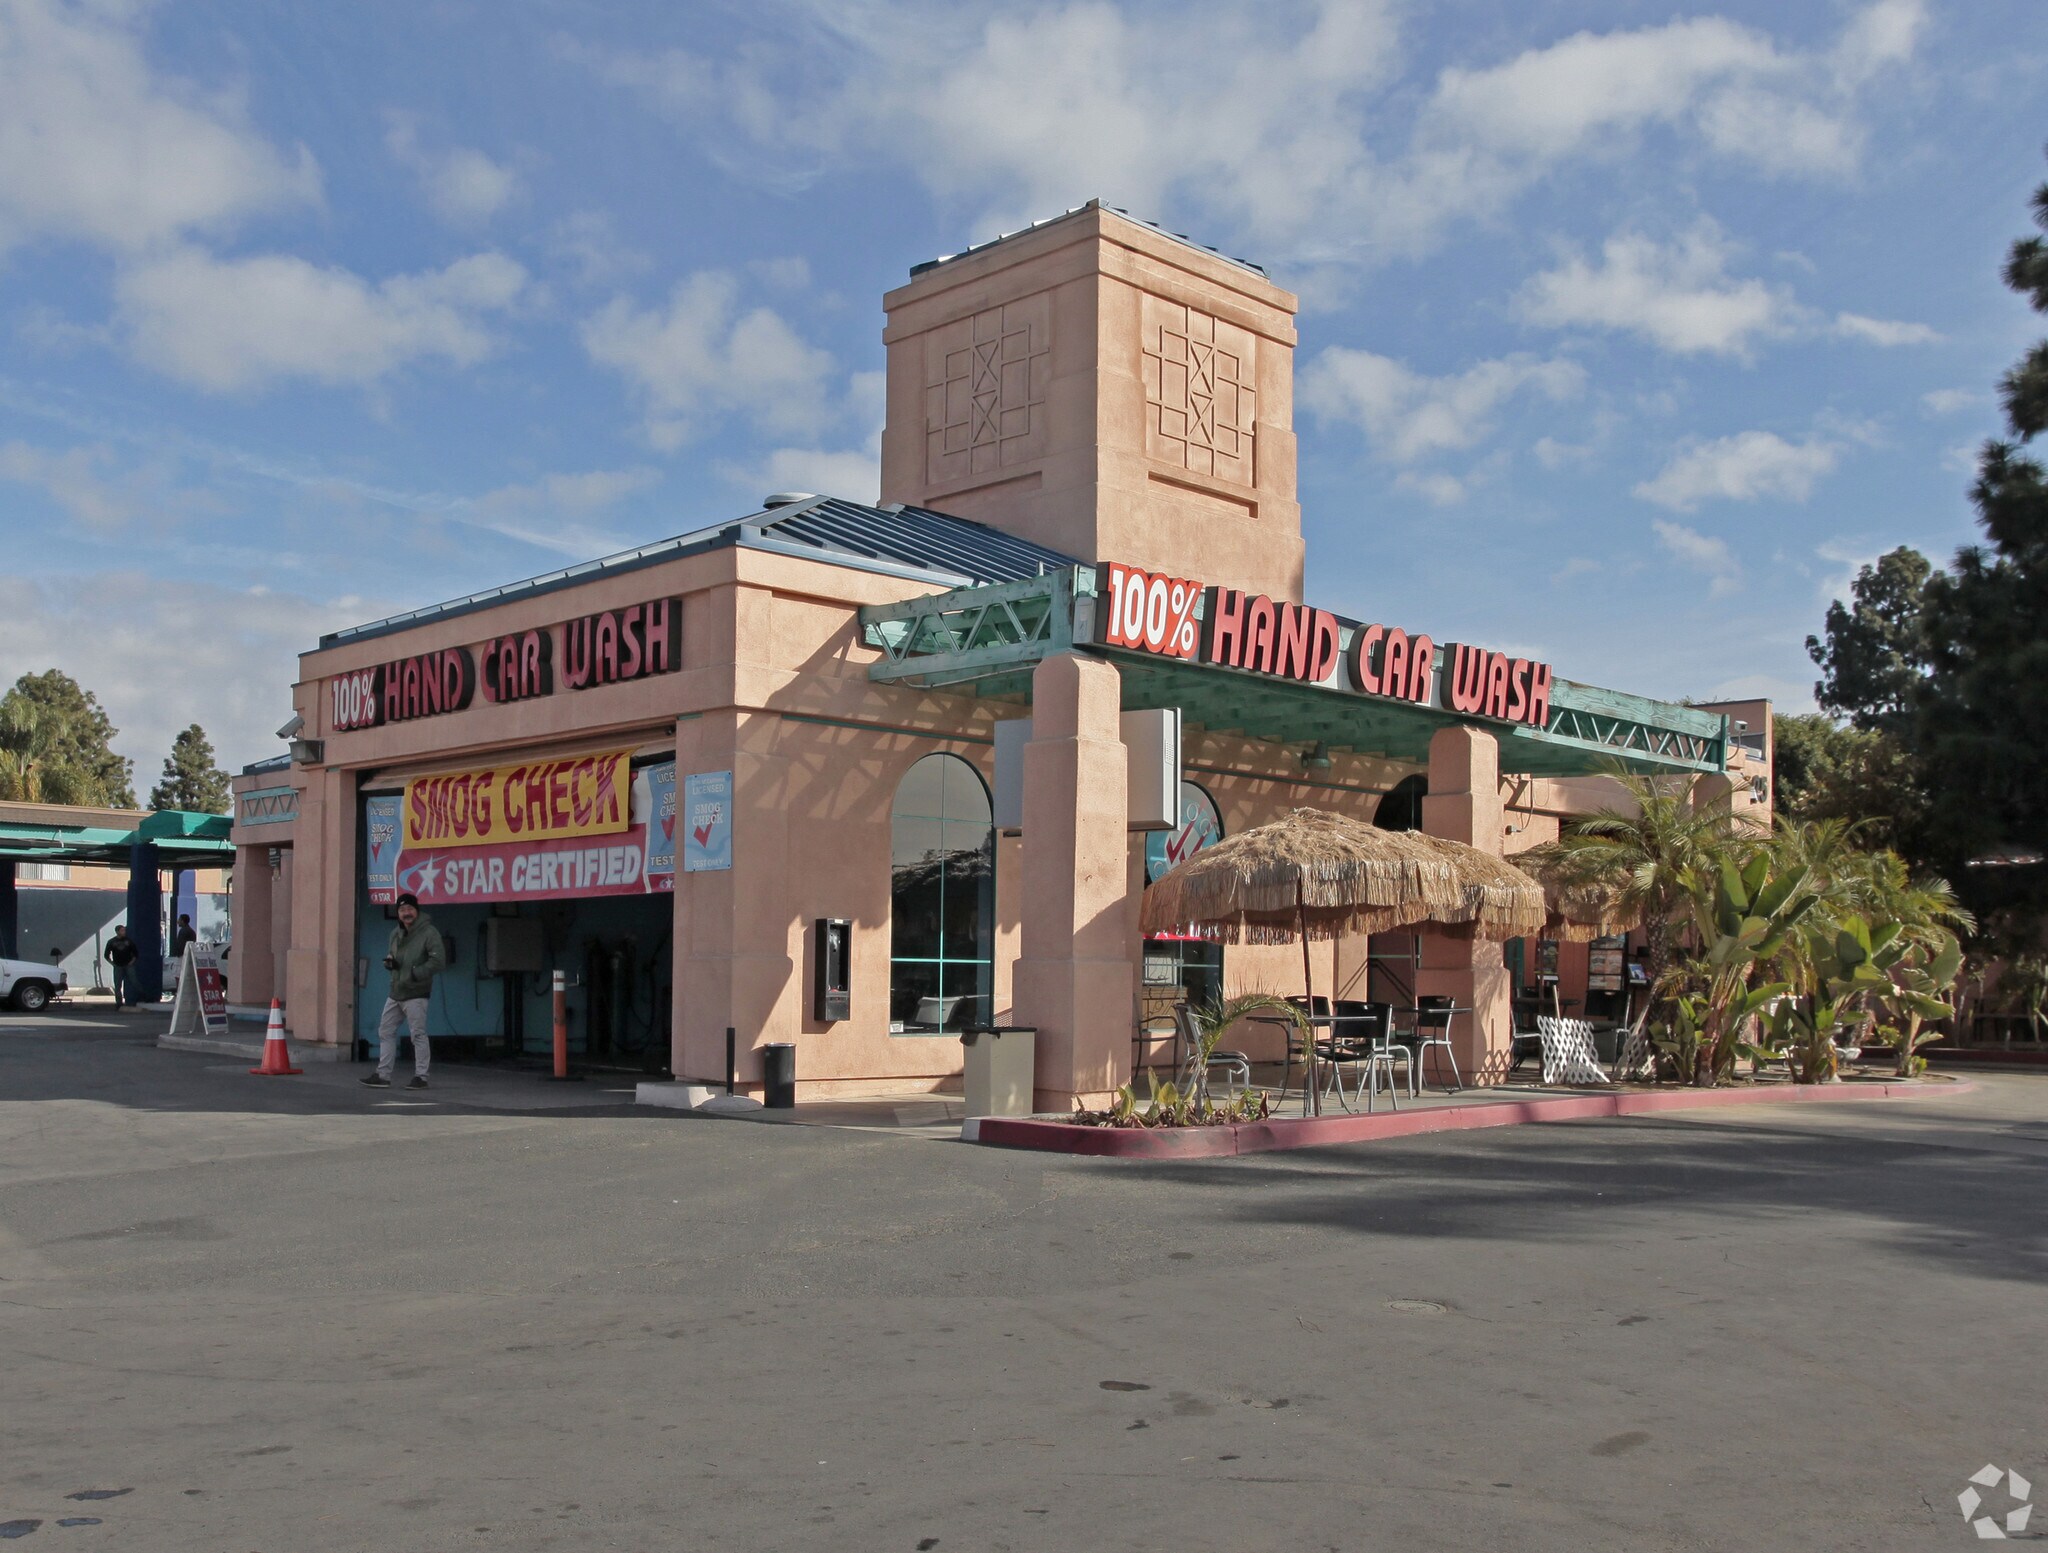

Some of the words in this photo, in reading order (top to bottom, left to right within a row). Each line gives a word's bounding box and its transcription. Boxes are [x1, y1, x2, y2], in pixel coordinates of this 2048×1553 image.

[1108, 564, 1200, 655] 100%
[1211, 585, 1339, 683] HAND
[1359, 623, 1434, 704] CAR
[1451, 642, 1552, 727] WASH
[332, 668, 376, 729] 100%
[384, 648, 465, 721] HAND
[480, 630, 541, 703] CAR
[560, 598, 669, 690] WASH
[410, 771, 495, 841] SMOG
[502, 752, 627, 834] CHECK
[692, 783, 725, 796] LICENSED
[692, 813, 724, 826] CHECK
[694, 801, 721, 815] SMOG
[444, 857, 505, 896] STAR
[511, 844, 642, 893] CERTIFIED
[203, 989, 220, 1001] STAR
